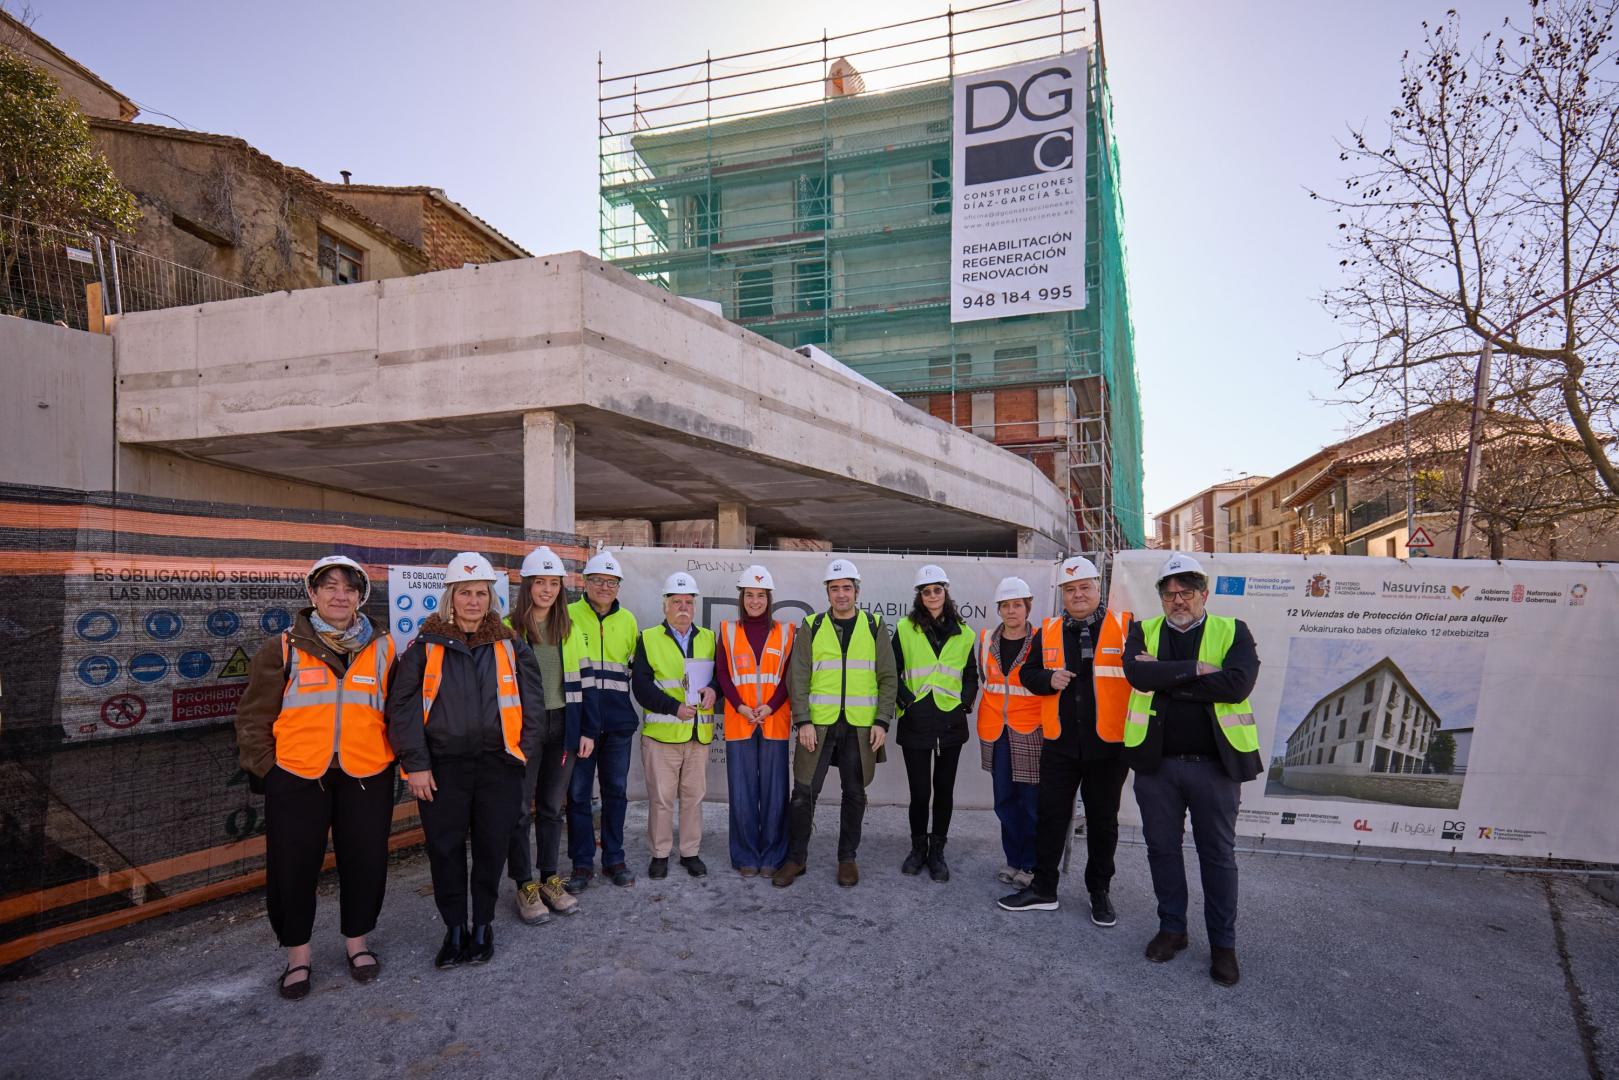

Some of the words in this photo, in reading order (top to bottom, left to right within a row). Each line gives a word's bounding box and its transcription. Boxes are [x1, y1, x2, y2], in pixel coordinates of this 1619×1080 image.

[966, 67, 1072, 135] DG
[1034, 130, 1073, 172] C
[964, 176, 1074, 201] CONSTRUCCIONES
[963, 192, 1050, 210] DÍAZ-GARCÍA
[1055, 187, 1074, 197] S.L.
[963, 232, 1072, 255] REHABILITACIÓN
[962, 247, 1066, 269] REGENERACIÓN
[962, 263, 1048, 283] RENOVACIÓN
[963, 293, 996, 309] 948
[1001, 290, 1031, 305] 184
[1038, 285, 1073, 301] 995
[94, 567, 114, 582] ES
[120, 568, 226, 583] OBLIGATORIO
[230, 570, 281, 584] SEGUIR
[403, 571, 412, 580] ES
[413, 572, 446, 581] OBLIGATO
[110, 586, 140, 601] LAS
[146, 586, 212, 601] NORMAS
[217, 586, 237, 601] DE
[240, 586, 307, 600] SEGURIDA
[408, 581, 422, 590] LAS
[423, 582, 446, 590] NORMA
[1383, 581, 1447, 594] Nasuvinsa
[1480, 588, 1510, 596] Gobierno
[1525, 597, 1557, 605] Gobernua
[1526, 590, 1562, 598] Nafarroako
[1286, 609, 1298, 618] 12
[1300, 609, 1344, 619] Viviendas
[1347, 610, 1360, 620] de
[1362, 611, 1412, 621] Protección
[1415, 612, 1447, 622] Oficial
[1448, 614, 1468, 624] para
[1471, 613, 1508, 625] alquiler
[1299, 624, 1355, 635] Alokairurako
[1356, 625, 1382, 635] babes
[1384, 626, 1428, 636] ofizialeko
[1431, 628, 1441, 637] 12
[1442, 628, 1489, 638] etxebizitza
[176, 701, 238, 718] PERSONA
[1442, 820, 1466, 832] DG
